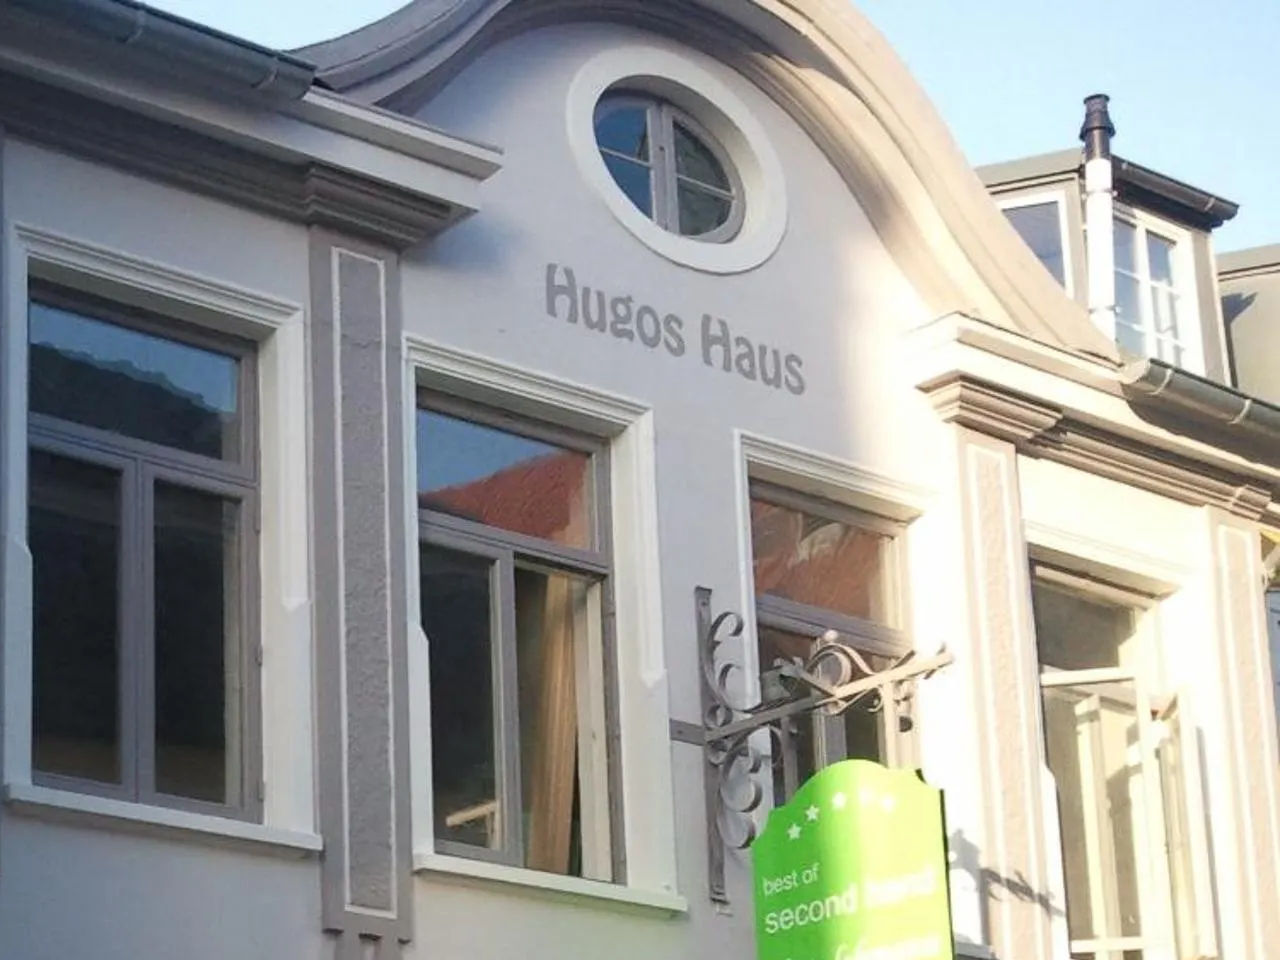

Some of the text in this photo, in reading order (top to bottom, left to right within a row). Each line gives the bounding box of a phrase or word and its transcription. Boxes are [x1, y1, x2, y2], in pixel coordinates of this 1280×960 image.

[545, 262, 805, 396] Hugos Haus
[763, 862, 819, 896] best of
[765, 882, 858, 934] second
